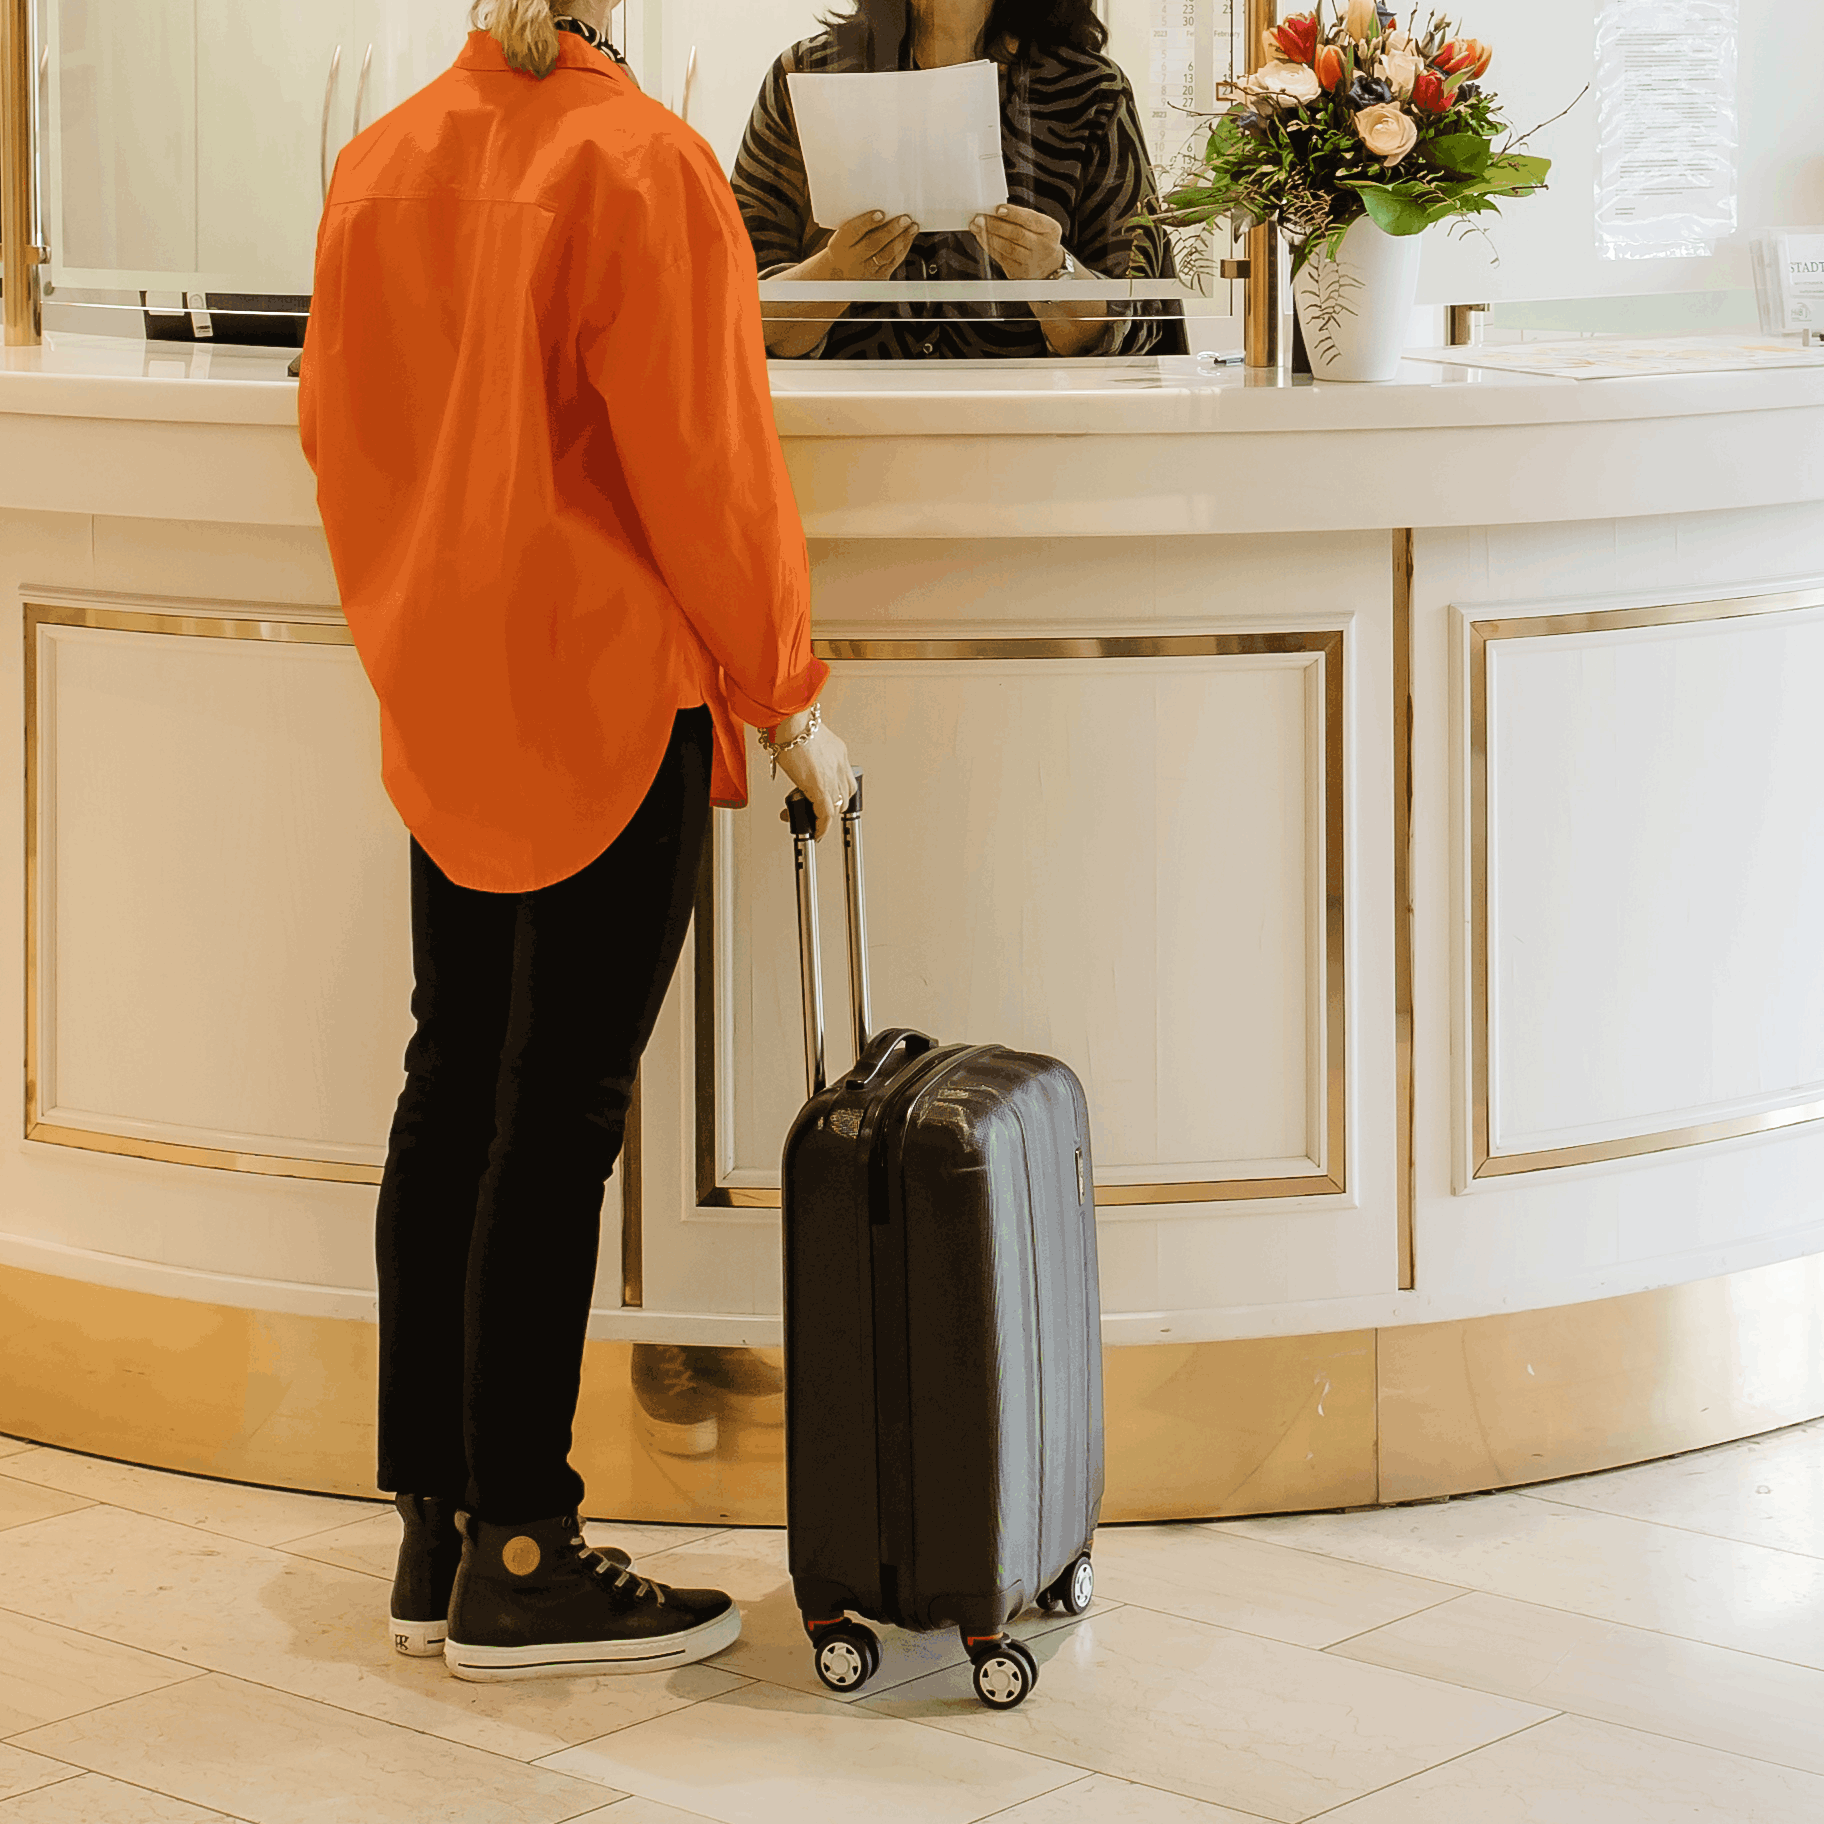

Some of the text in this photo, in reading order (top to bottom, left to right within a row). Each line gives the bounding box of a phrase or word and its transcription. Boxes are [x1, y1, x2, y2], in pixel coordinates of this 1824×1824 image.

[1182, 4, 1195, 14] 23
[1182, 16, 1194, 26] 30
[1188, 62, 1194, 72] 6
[1183, 74, 1194, 84] 13
[1182, 86, 1194, 96] 20
[1182, 98, 1194, 108] 27
[1187, 143, 1193, 152] 6
